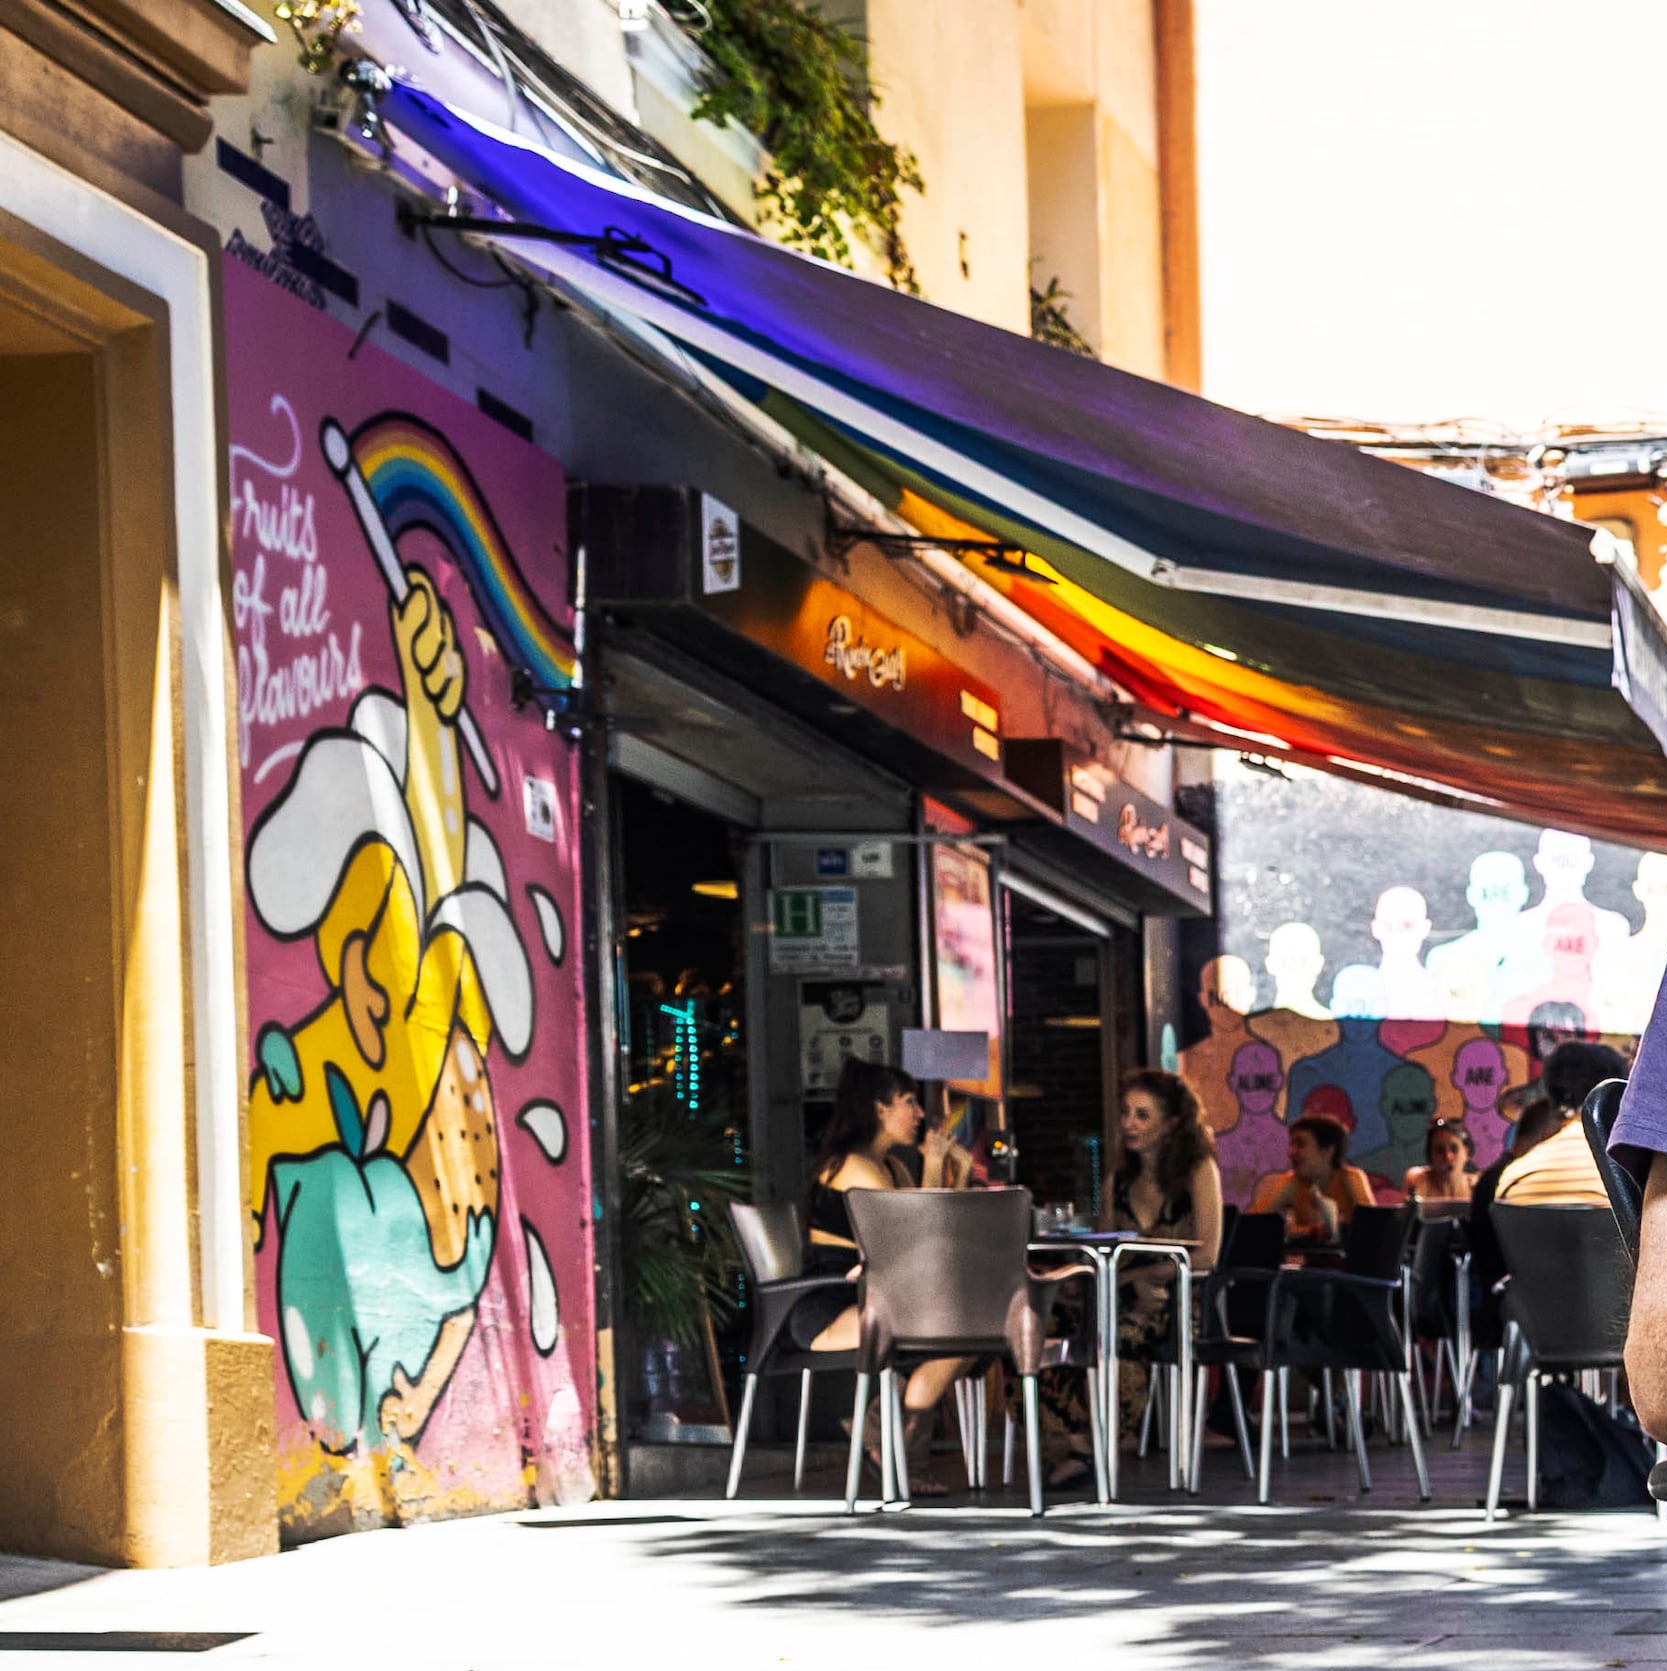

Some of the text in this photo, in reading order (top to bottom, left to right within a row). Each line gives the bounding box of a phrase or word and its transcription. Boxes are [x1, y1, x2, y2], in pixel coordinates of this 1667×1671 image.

[233, 553, 331, 648] of all
[238, 620, 363, 768] flavours
[1554, 936, 1587, 953] ARE
[1464, 1066, 1496, 1086] ARE
